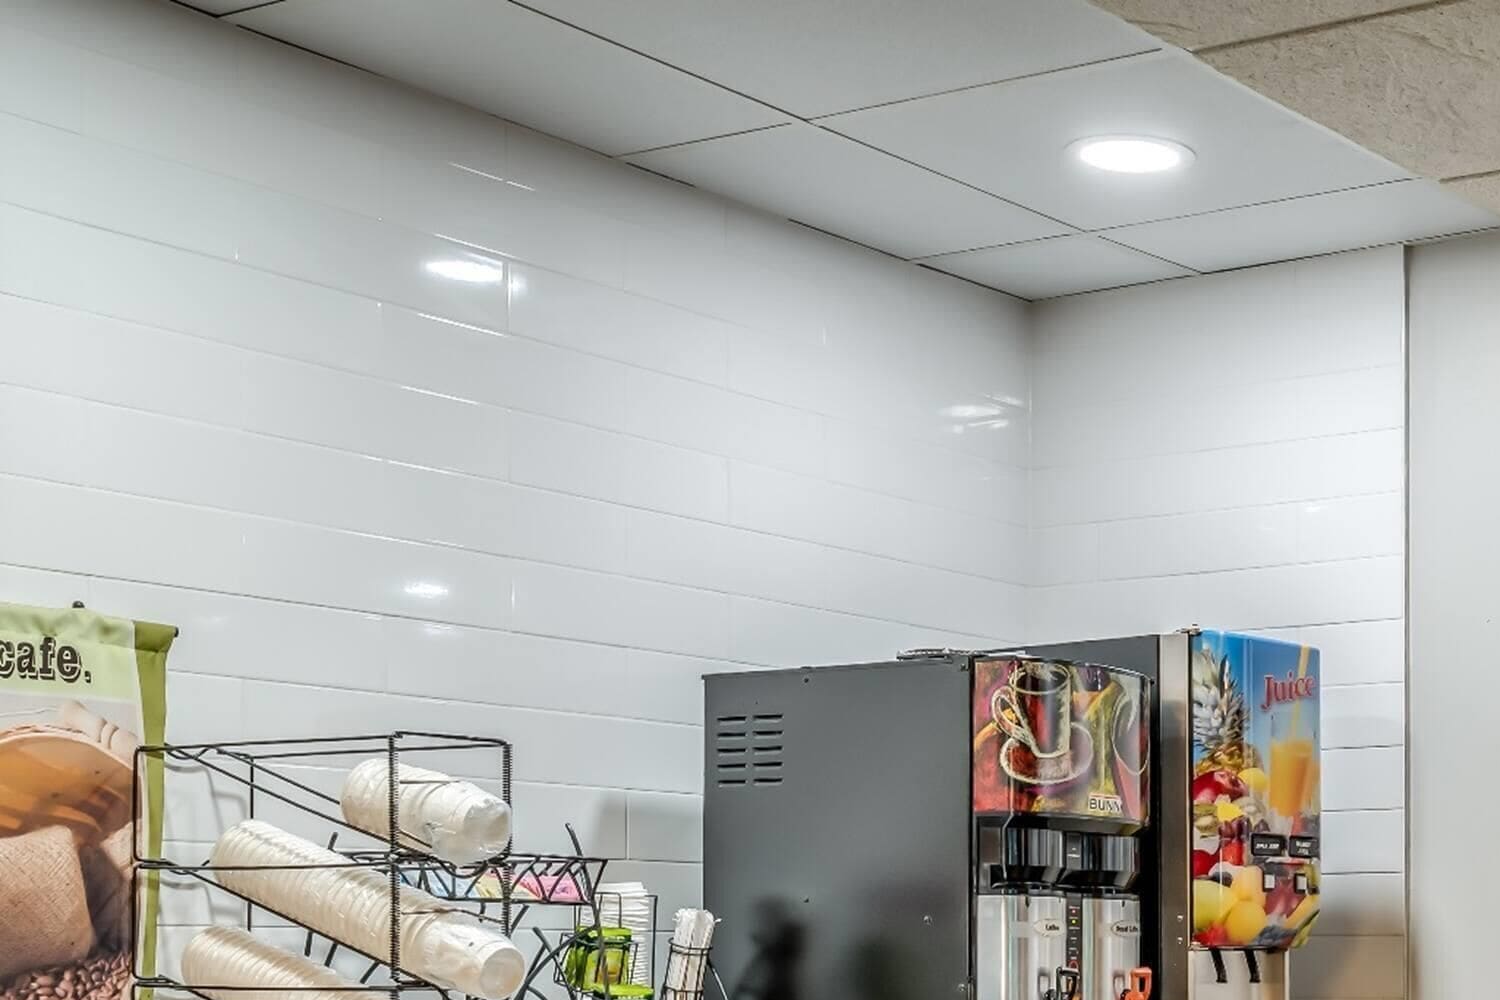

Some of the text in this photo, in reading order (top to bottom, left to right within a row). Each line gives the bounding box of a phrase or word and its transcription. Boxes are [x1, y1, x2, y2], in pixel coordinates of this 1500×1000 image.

[0, 636, 92, 684] cafe.
[1260, 671, 1315, 712] Juice
[1090, 798, 1123, 811] BUNN
